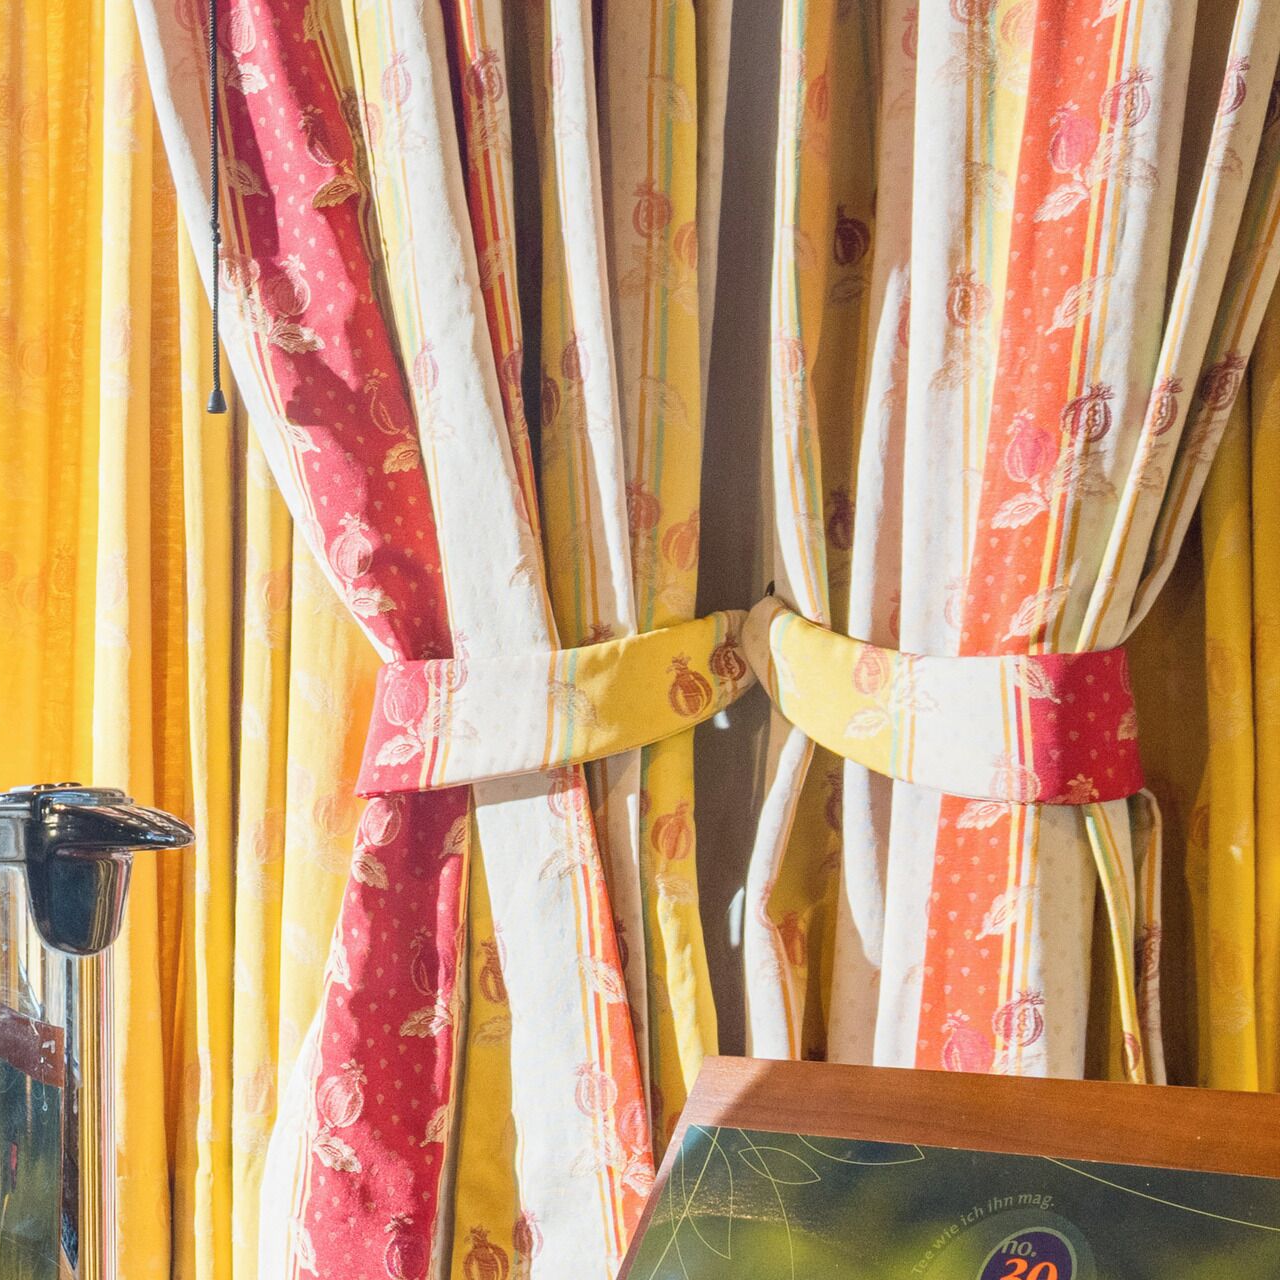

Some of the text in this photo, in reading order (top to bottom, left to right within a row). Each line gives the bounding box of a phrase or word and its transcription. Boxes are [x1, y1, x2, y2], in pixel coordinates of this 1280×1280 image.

[912, 1193, 1054, 1274] Tee wie ich ihn mag.
[1001, 1240, 1037, 1257] no.
